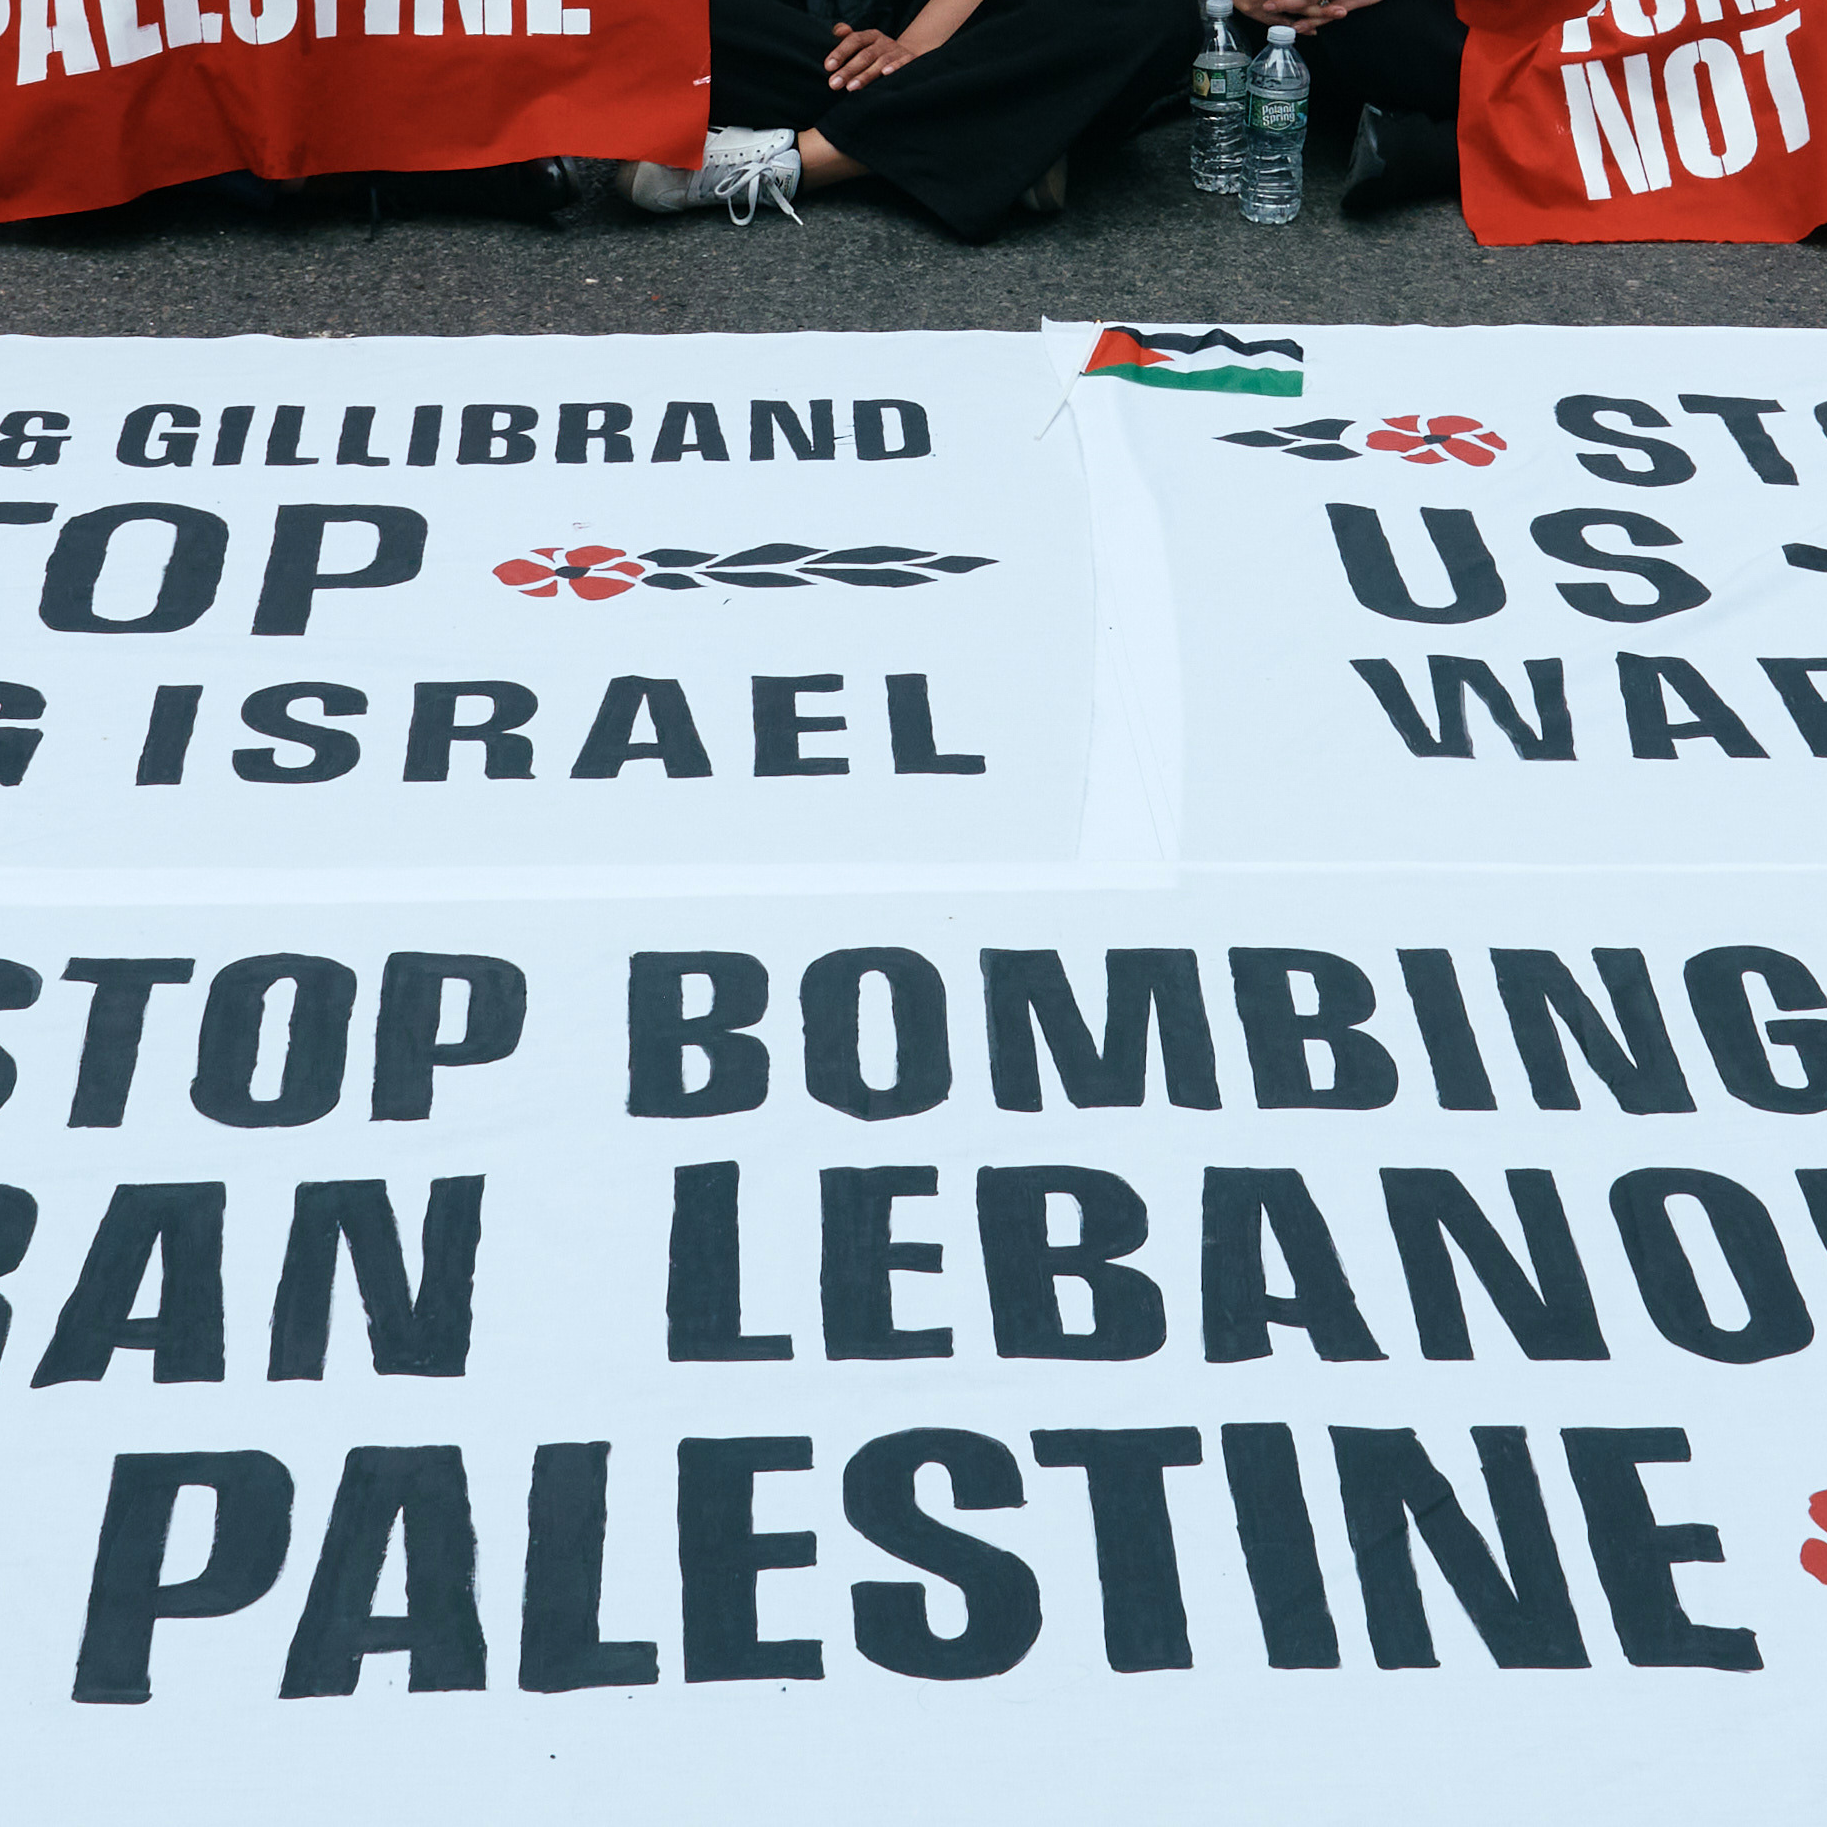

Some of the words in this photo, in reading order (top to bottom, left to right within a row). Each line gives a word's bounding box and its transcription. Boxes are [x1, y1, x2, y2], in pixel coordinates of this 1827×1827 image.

[1559, 9, 1812, 201] NOT
[113, 396, 937, 469] GILLIBRAND
[1323, 501, 1712, 624] US
[135, 673, 988, 786] ISRAEL
[72, 1420, 1766, 1706] PALESTINE
